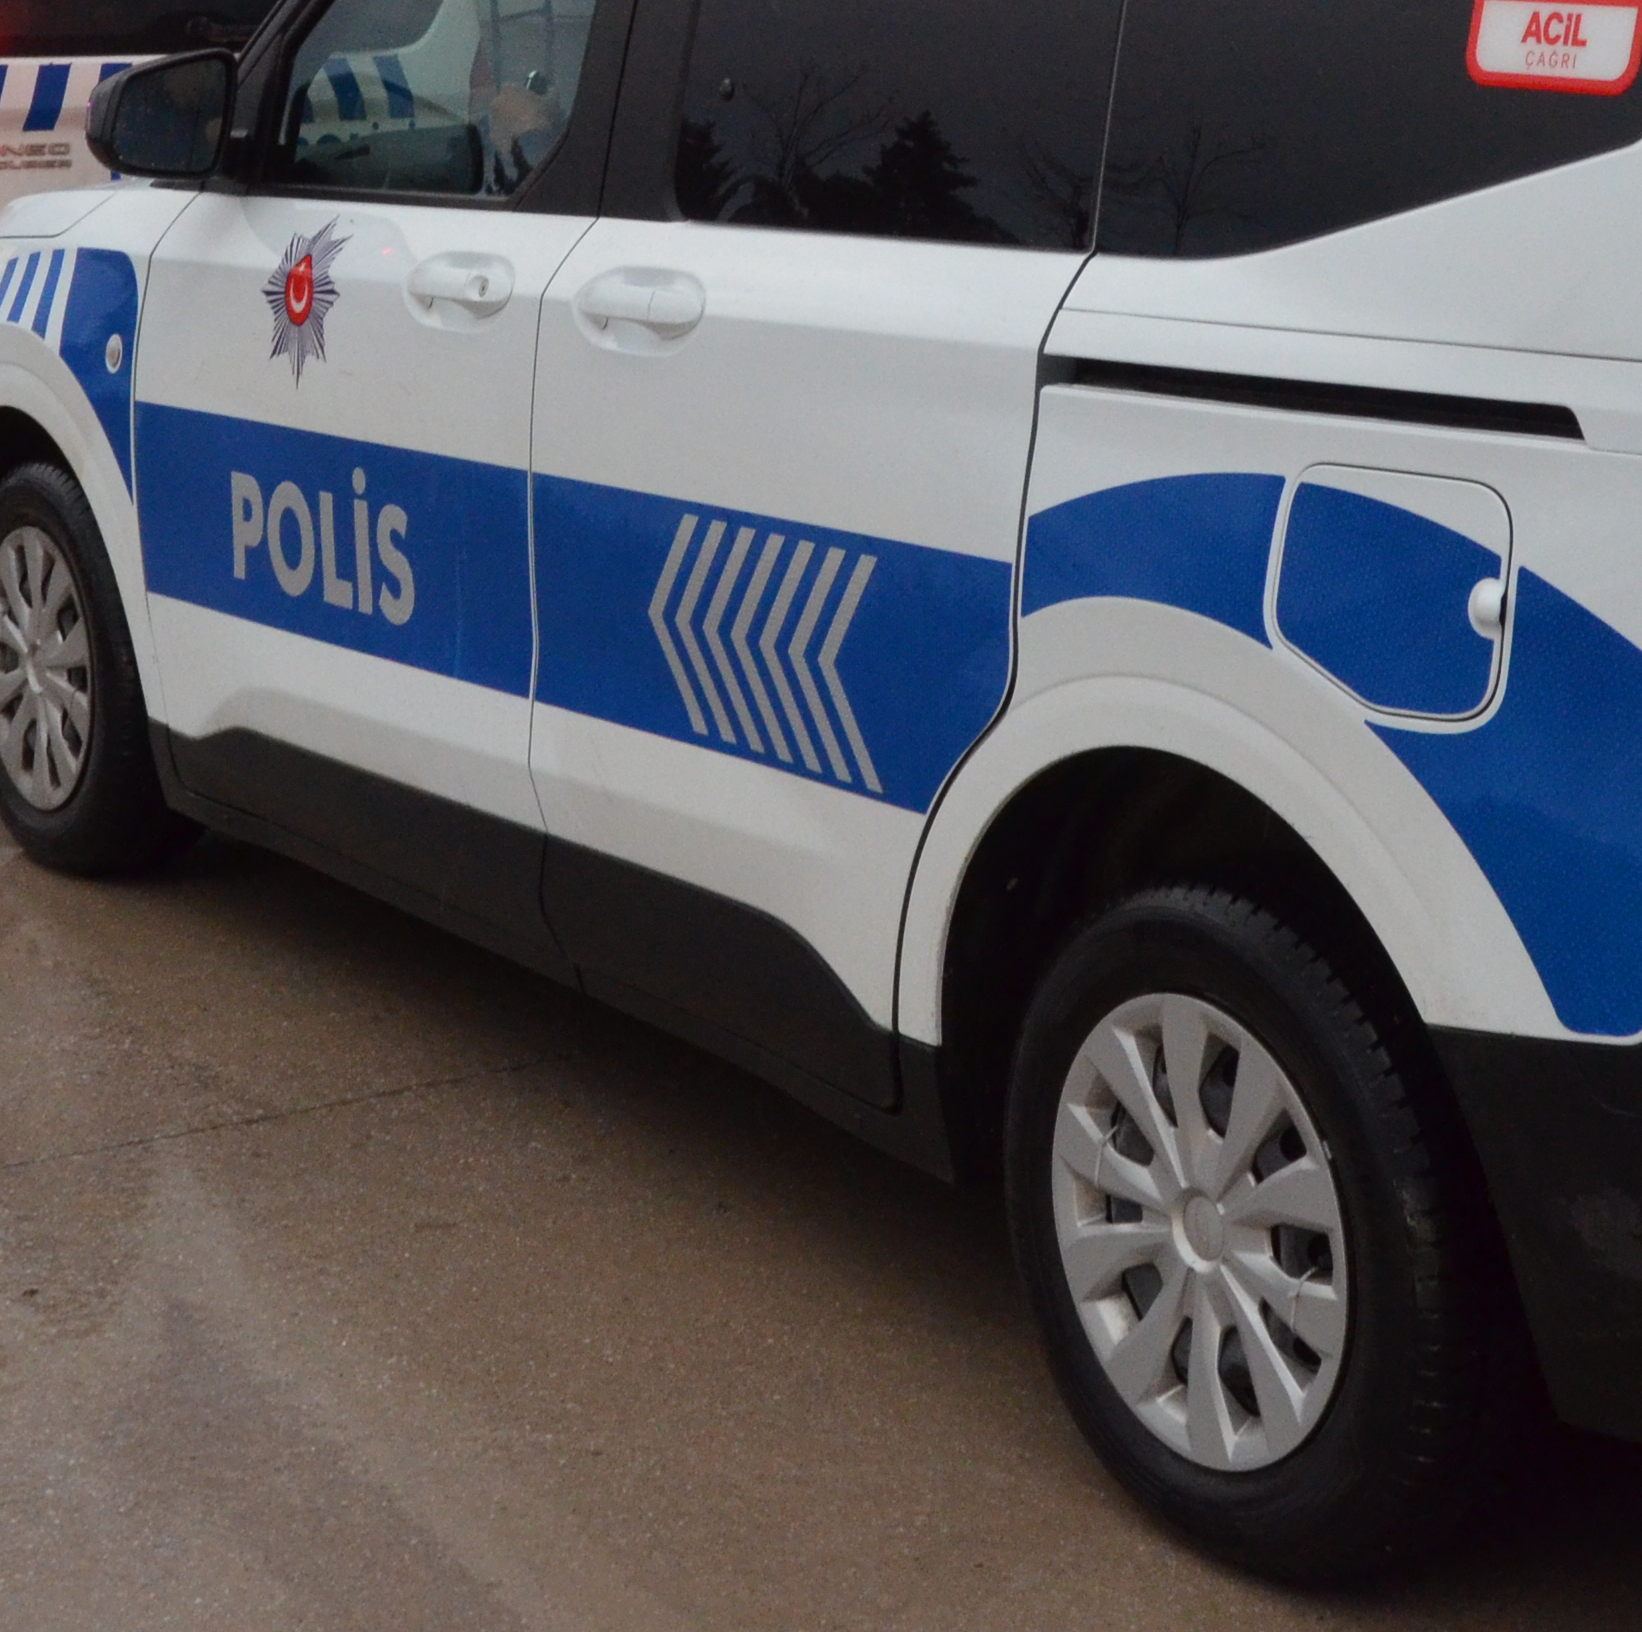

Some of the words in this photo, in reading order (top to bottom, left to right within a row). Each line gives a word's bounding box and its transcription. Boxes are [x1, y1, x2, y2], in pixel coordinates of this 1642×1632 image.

[1521, 10, 1588, 48] ACİL
[1525, 50, 1578, 71] ÇAĞRI
[229, 467, 416, 626] POLİS
